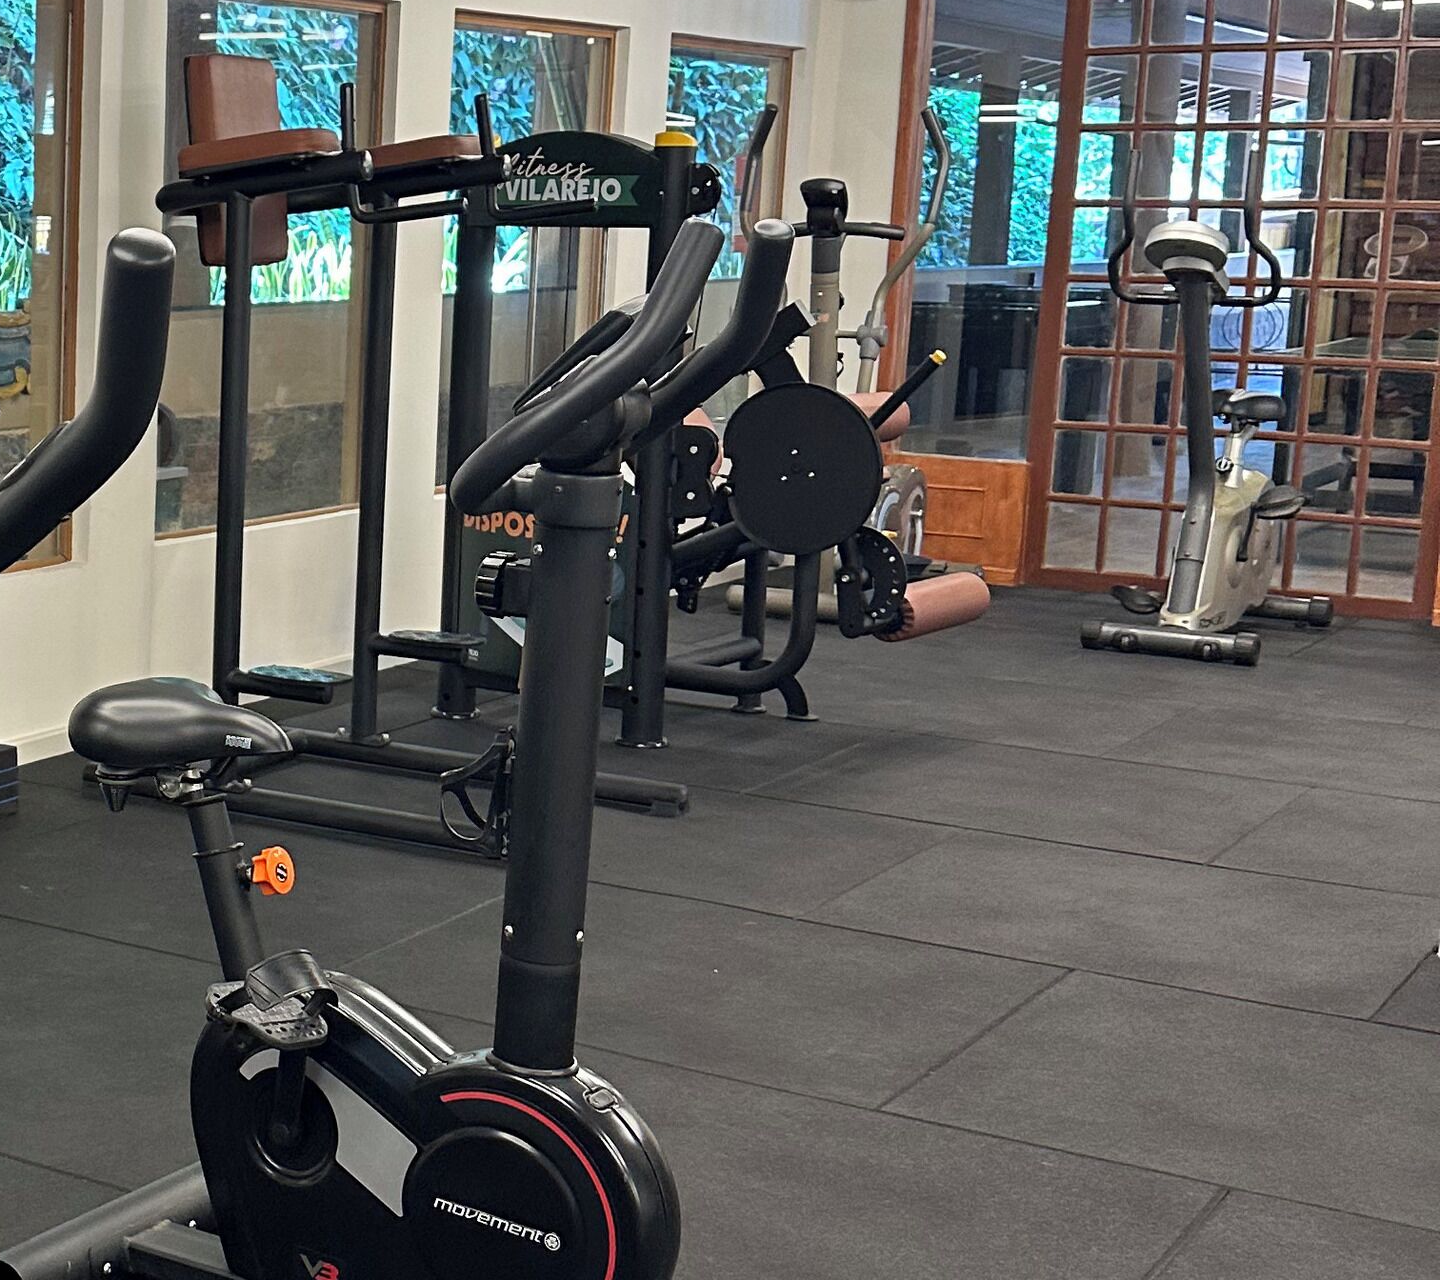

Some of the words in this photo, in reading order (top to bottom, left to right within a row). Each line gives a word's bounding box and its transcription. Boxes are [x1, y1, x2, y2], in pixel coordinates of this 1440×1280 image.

[505, 178, 622, 201] VILAREJO
[463, 511, 536, 538] DISPOS
[433, 1197, 544, 1243] movement
